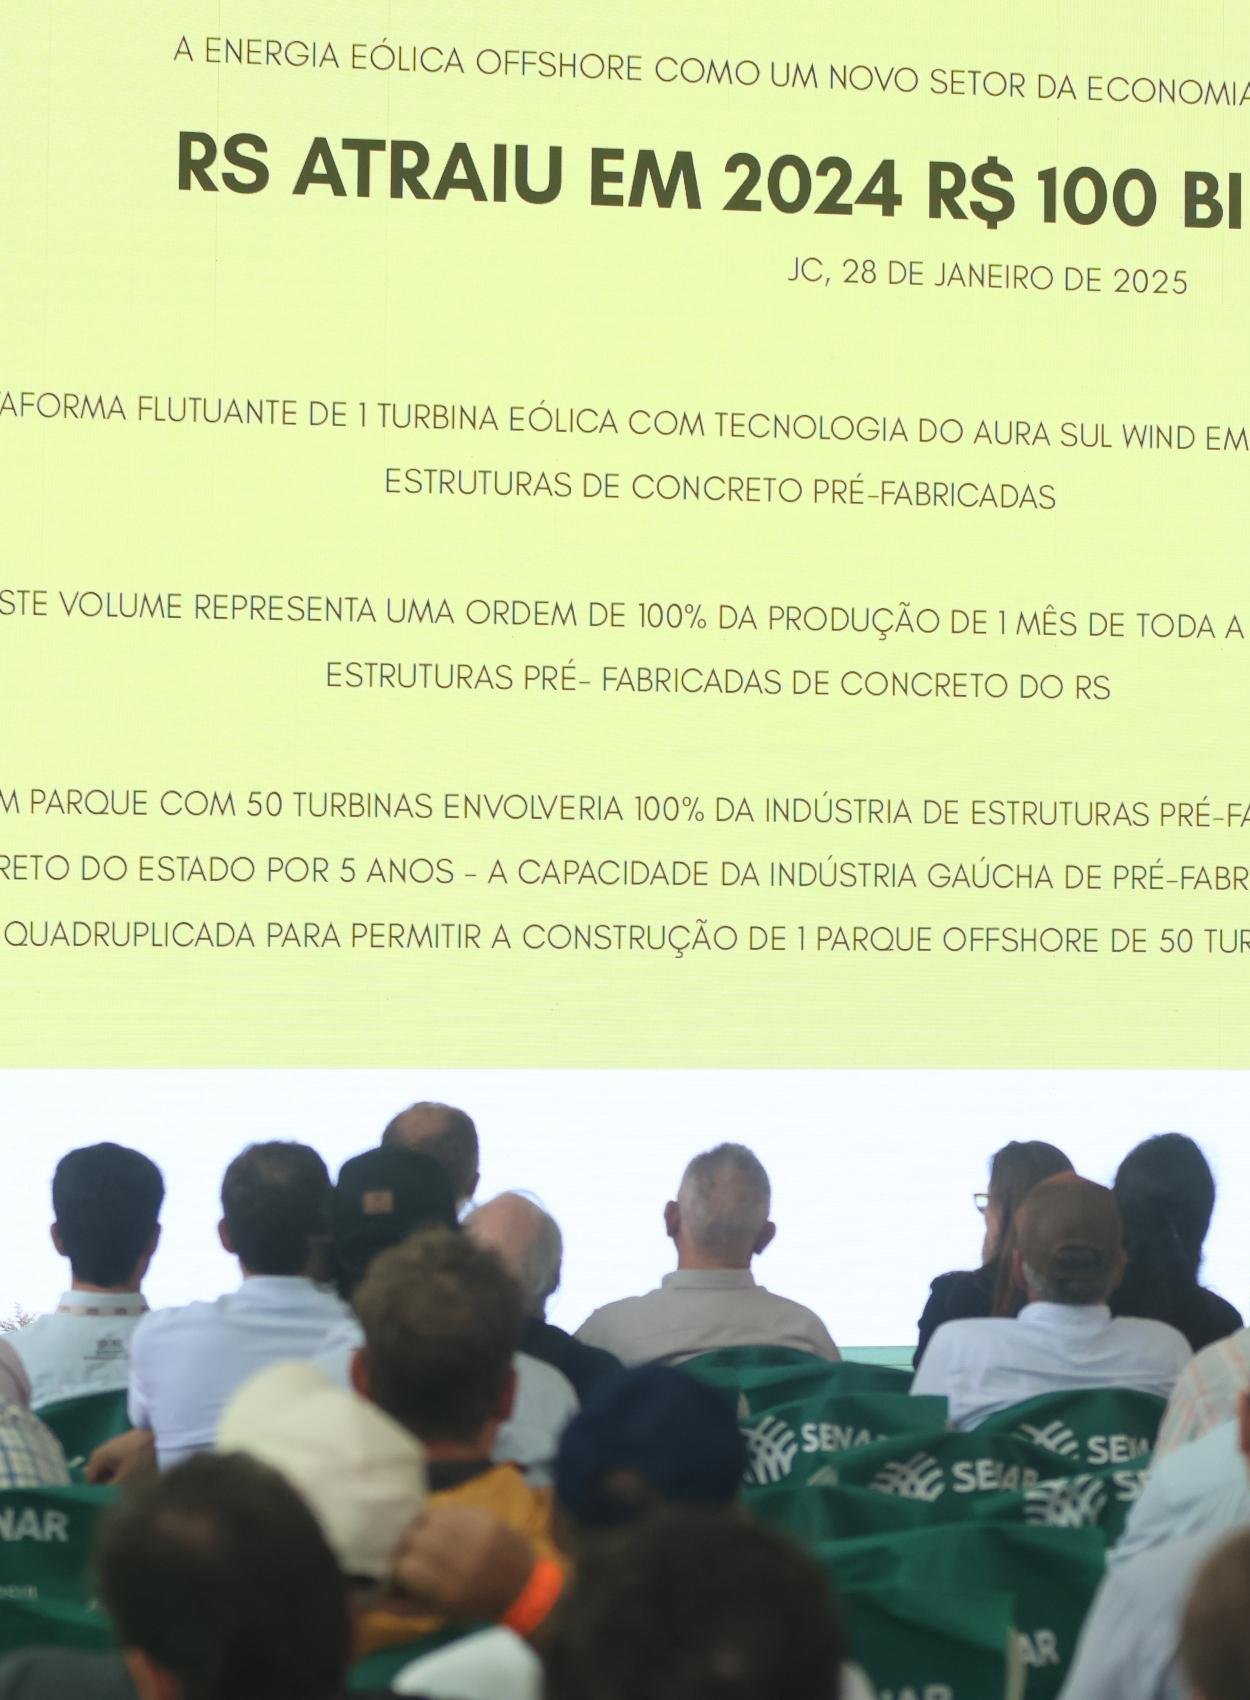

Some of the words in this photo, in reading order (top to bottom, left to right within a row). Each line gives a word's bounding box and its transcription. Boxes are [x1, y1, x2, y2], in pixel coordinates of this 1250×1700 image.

[173, 35, 193, 62] A
[206, 37, 339, 68] ENERGIA
[352, 37, 464, 73] EÓLICA
[477, 49, 642, 81] OFFSHORE
[655, 56, 760, 85] COMO
[771, 61, 818, 88] UM
[830, 64, 918, 92] NOVO
[930, 69, 1025, 98] SETOR
[1038, 74, 1077, 100] DA
[178, 131, 269, 194] RS
[292, 137, 562, 205] ATRAIU
[591, 147, 702, 209] EM
[722, 152, 902, 217] 2024
[929, 155, 1015, 230] R$
[1038, 166, 1157, 227] 100
[1184, 171, 1241, 229] BI
[788, 257, 830, 287] JC,
[843, 259, 876, 284] 28
[889, 260, 923, 285] DE
[934, 262, 1053, 290] JANEIRO
[1065, 267, 1101, 291] DE
[1114, 268, 1187, 294] 2025
[0, 391, 126, 420] AFORMA
[139, 396, 296, 425] FLUTUANTE
[310, 401, 347, 426] DE
[377, 403, 499, 430] TURBINA
[510, 400, 618, 434] EÓLICA
[629, 410, 704, 436] COM
[715, 412, 908, 442] TECNOLOGIA
[919, 418, 963, 443] DO
[973, 420, 1050, 446] AURA
[1061, 422, 1112, 448] SUL
[1123, 424, 1195, 449] WIND
[386, 468, 571, 497] ESTRUTURAS
[584, 473, 619, 498] DE
[632, 474, 802, 503] CONCRETO
[814, 473, 1055, 509] PRÉ-FABRICADAS
[59, 591, 181, 618] VOLUME
[195, 594, 376, 622] REPRESENTA
[387, 598, 454, 624] UMA
[466, 600, 577, 626] ORDEM
[589, 602, 625, 627] DE
[639, 603, 706, 629] 100%
[720, 604, 757, 630] DA
[769, 602, 940, 641] PRODUÇÃO
[952, 609, 987, 634] DE
[1016, 604, 1077, 636] MÊS
[1090, 612, 1124, 637] DE
[1136, 613, 1215, 638] TODA
[1225, 614, 1244, 639] A
[327, 662, 513, 690] ESTRUTURAS
[603, 667, 781, 694] FABRICADAS
[793, 670, 829, 695] DE
[841, 671, 1008, 698] CONCRETO
[1020, 674, 1063, 699] DO
[1076, 675, 1110, 700] RS
[31, 789, 147, 815] PARQUE
[160, 790, 235, 816] COM
[247, 791, 282, 817] 50
[293, 792, 432, 818] TURBINAS
[444, 793, 623, 820] ENVOLVERIA
[635, 796, 704, 821] 100%
[716, 797, 754, 822] DA
[766, 791, 912, 824] INDÚSTRIA
[924, 800, 958, 824] DE
[972, 800, 1149, 826] ESTRUTURAS
[82, 855, 127, 881] DO
[139, 856, 255, 882] ESTADO
[268, 857, 328, 882] POR
[340, 857, 355, 882] 5
[366, 857, 453, 884] ANOS
[488, 859, 508, 884] A
[518, 859, 708, 886] CAPACIDADE
[722, 861, 760, 886] DA
[771, 855, 917, 887] INDÚSTRIA
[928, 856, 1053, 888] GAÚCHA
[1065, 865, 1101, 889] DE
[4, 921, 255, 947] QUADRUPLICADA
[268, 922, 341, 948] PARA
[352, 923, 480, 948] PERMITIR
[491, 923, 511, 949] A
[523, 919, 737, 958] CONSTRUÇÃO
[750, 926, 786, 950] DE
[818, 926, 931, 951] PARQUE
[943, 927, 1098, 952] OFFSHORE
[1112, 928, 1146, 952] DE
[1160, 929, 1193, 953] 50
[801, 1423, 888, 1453] SENA
